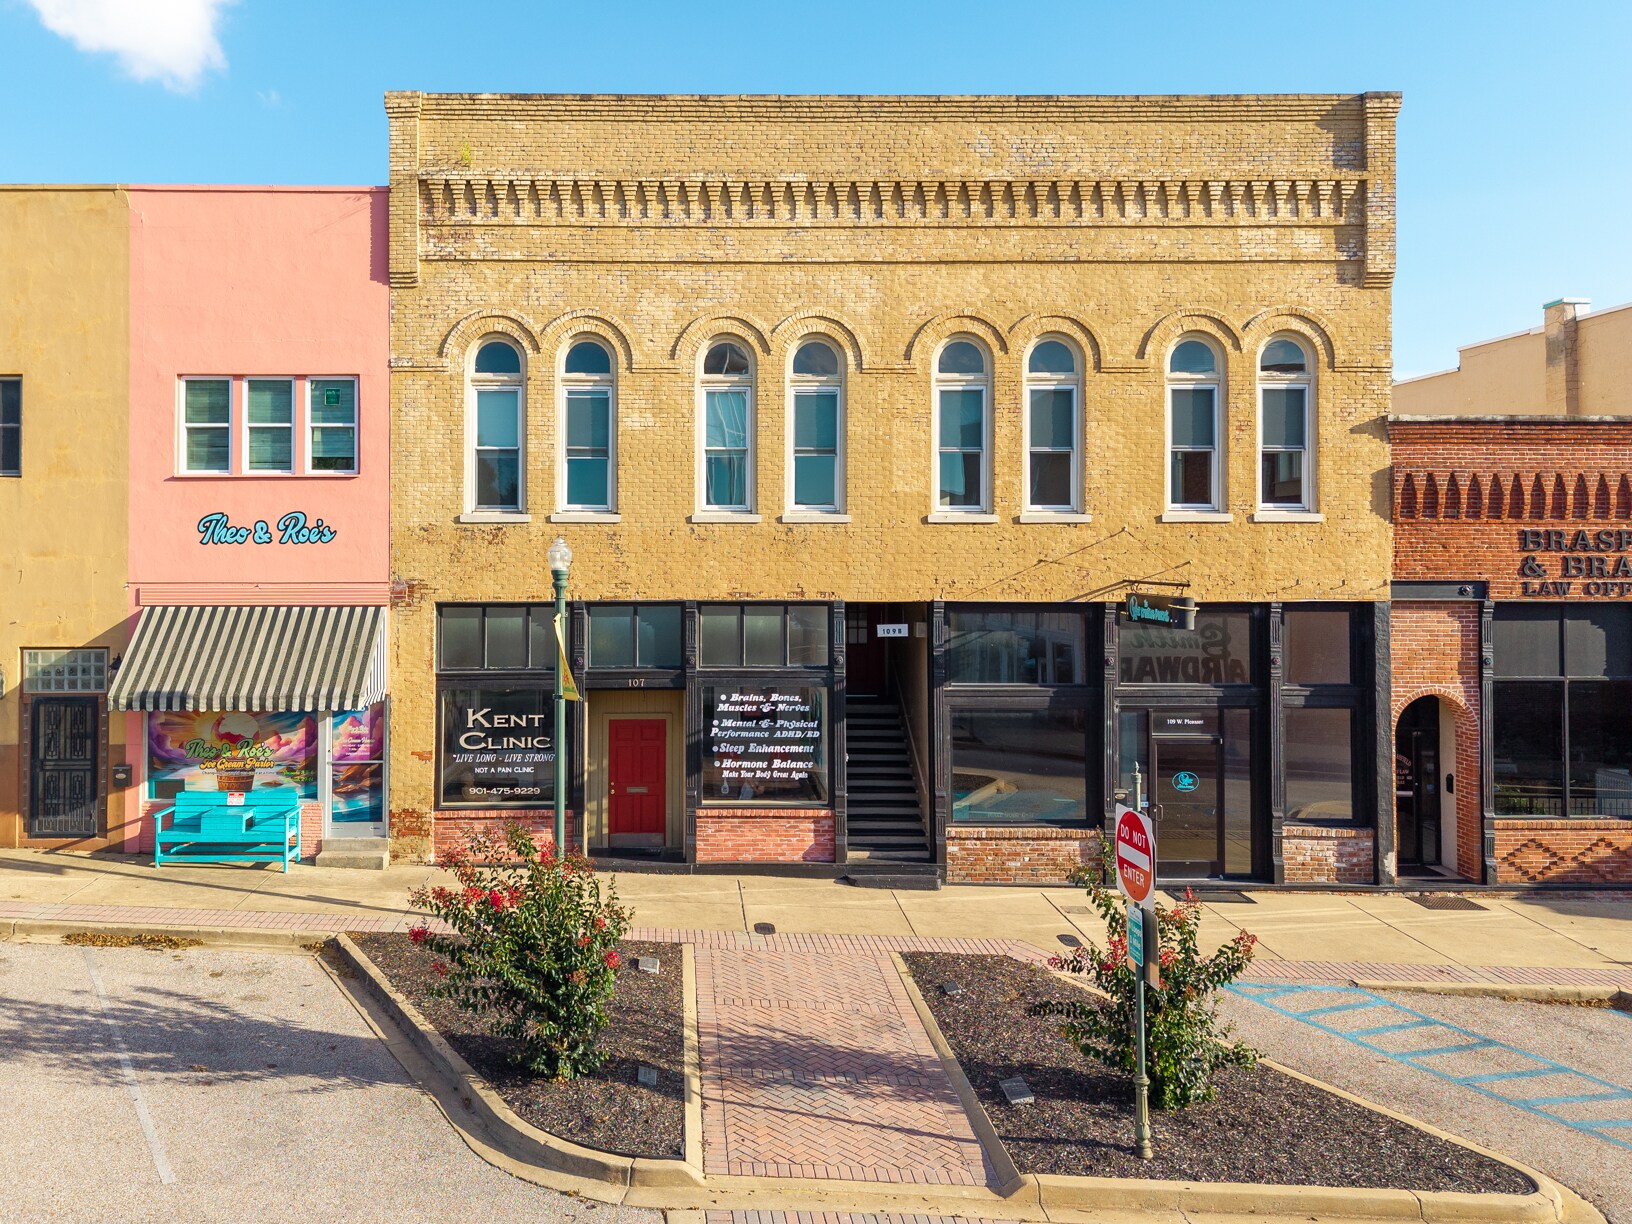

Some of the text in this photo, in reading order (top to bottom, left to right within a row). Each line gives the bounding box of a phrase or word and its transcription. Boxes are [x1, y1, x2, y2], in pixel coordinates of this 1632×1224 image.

[197, 511, 337, 544] Theo & Roe's
[1523, 555, 1547, 577] &
[1524, 582, 1570, 597] LAW
[628, 679, 644, 687] 107
[730, 694, 802, 702] Brains, Bones,
[760, 703, 775, 712] &
[466, 708, 544, 728] KENT
[721, 719, 818, 729] Mental & Physical
[710, 728, 820, 738] Performance ADHD/ED
[459, 732, 551, 750] CLINIC
[185, 738, 274, 759] Theo & Roe's
[720, 743, 814, 753] Sleep Enhancement
[476, 754, 496, 763] LONG
[504, 754, 522, 763] LIVE
[721, 759, 814, 768] Hormone Balance
[216, 758, 244, 770] Cream
[245, 758, 275, 769] Parlor
[722, 770, 808, 780] Make Your Body Great Again
[469, 787, 541, 795] 901-475-9229
[1120, 824, 1146, 849] DO NOT
[1123, 864, 1145, 888] ENTER
